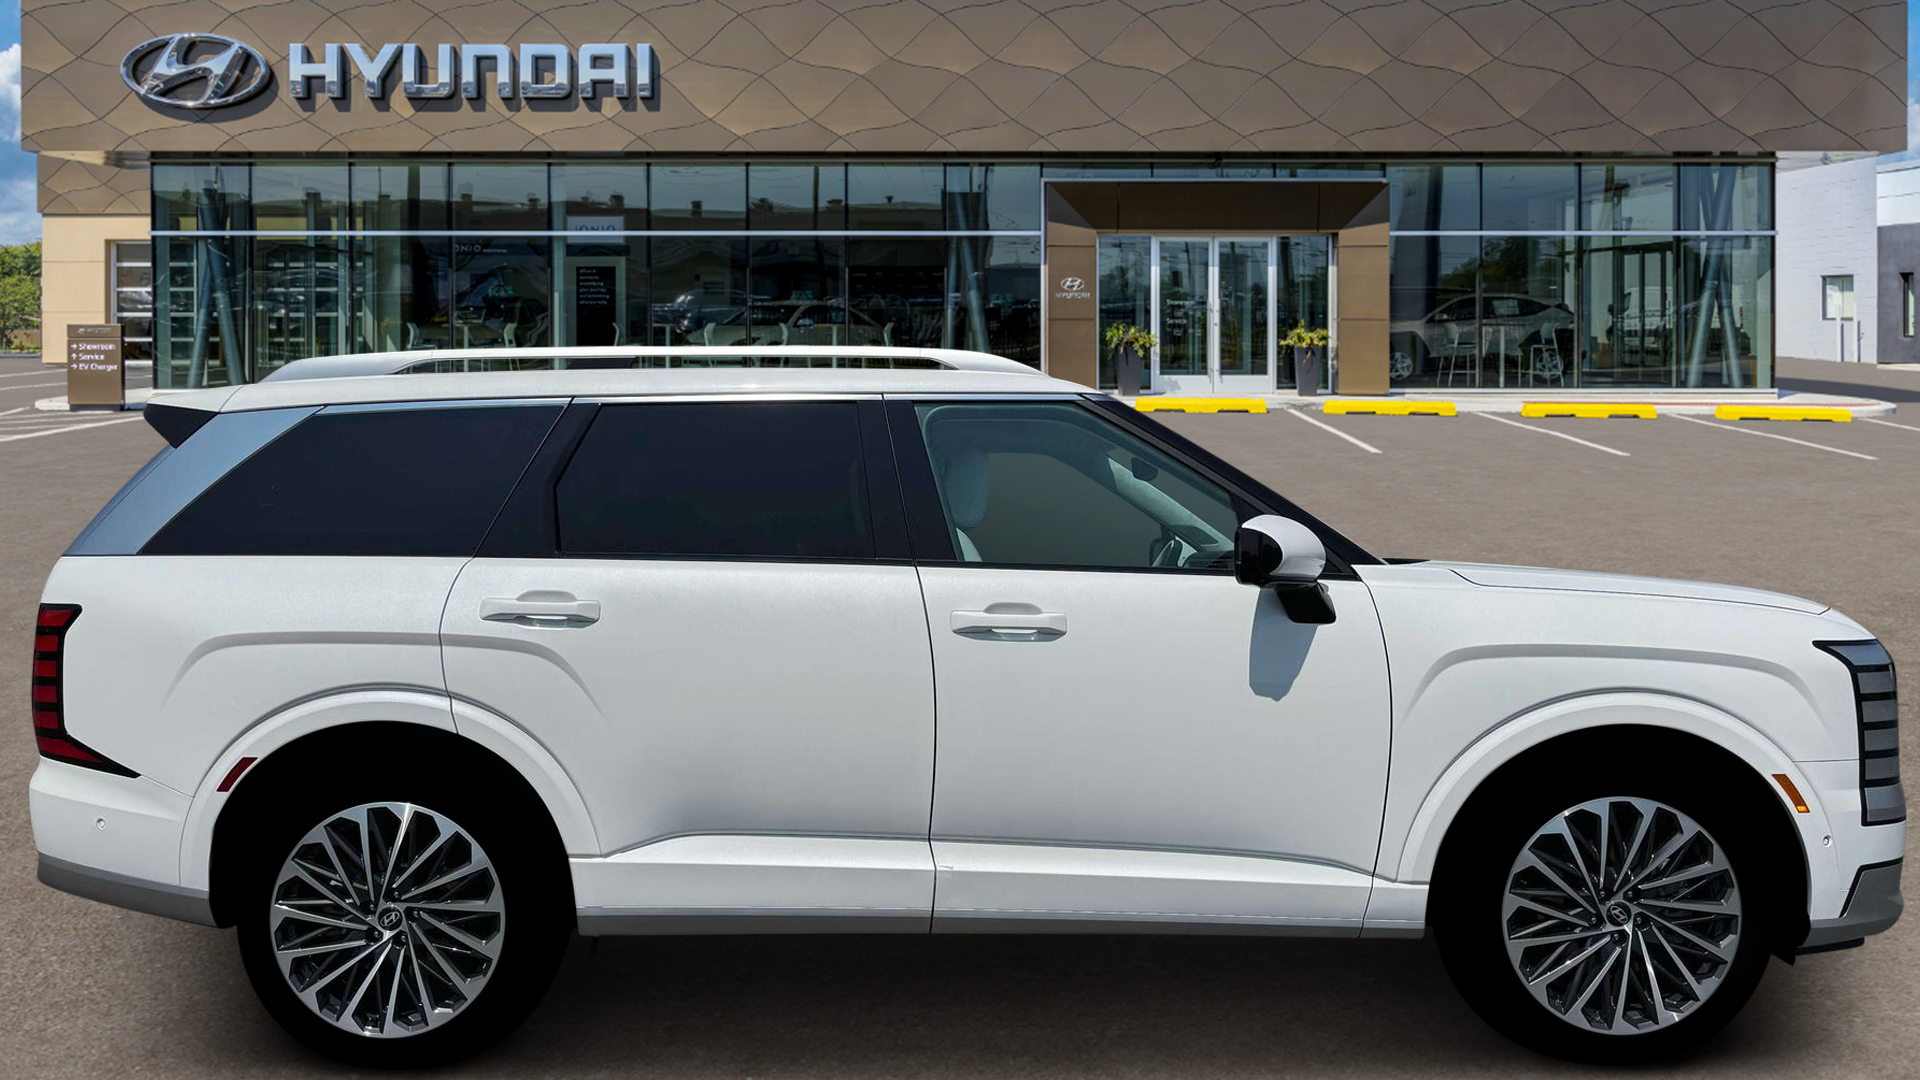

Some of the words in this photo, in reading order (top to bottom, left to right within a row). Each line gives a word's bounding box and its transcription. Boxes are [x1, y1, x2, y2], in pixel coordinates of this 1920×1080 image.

[289, 43, 654, 98] HYUNDAI
[79, 352, 105, 360] Service
[90, 363, 118, 372] Charger
